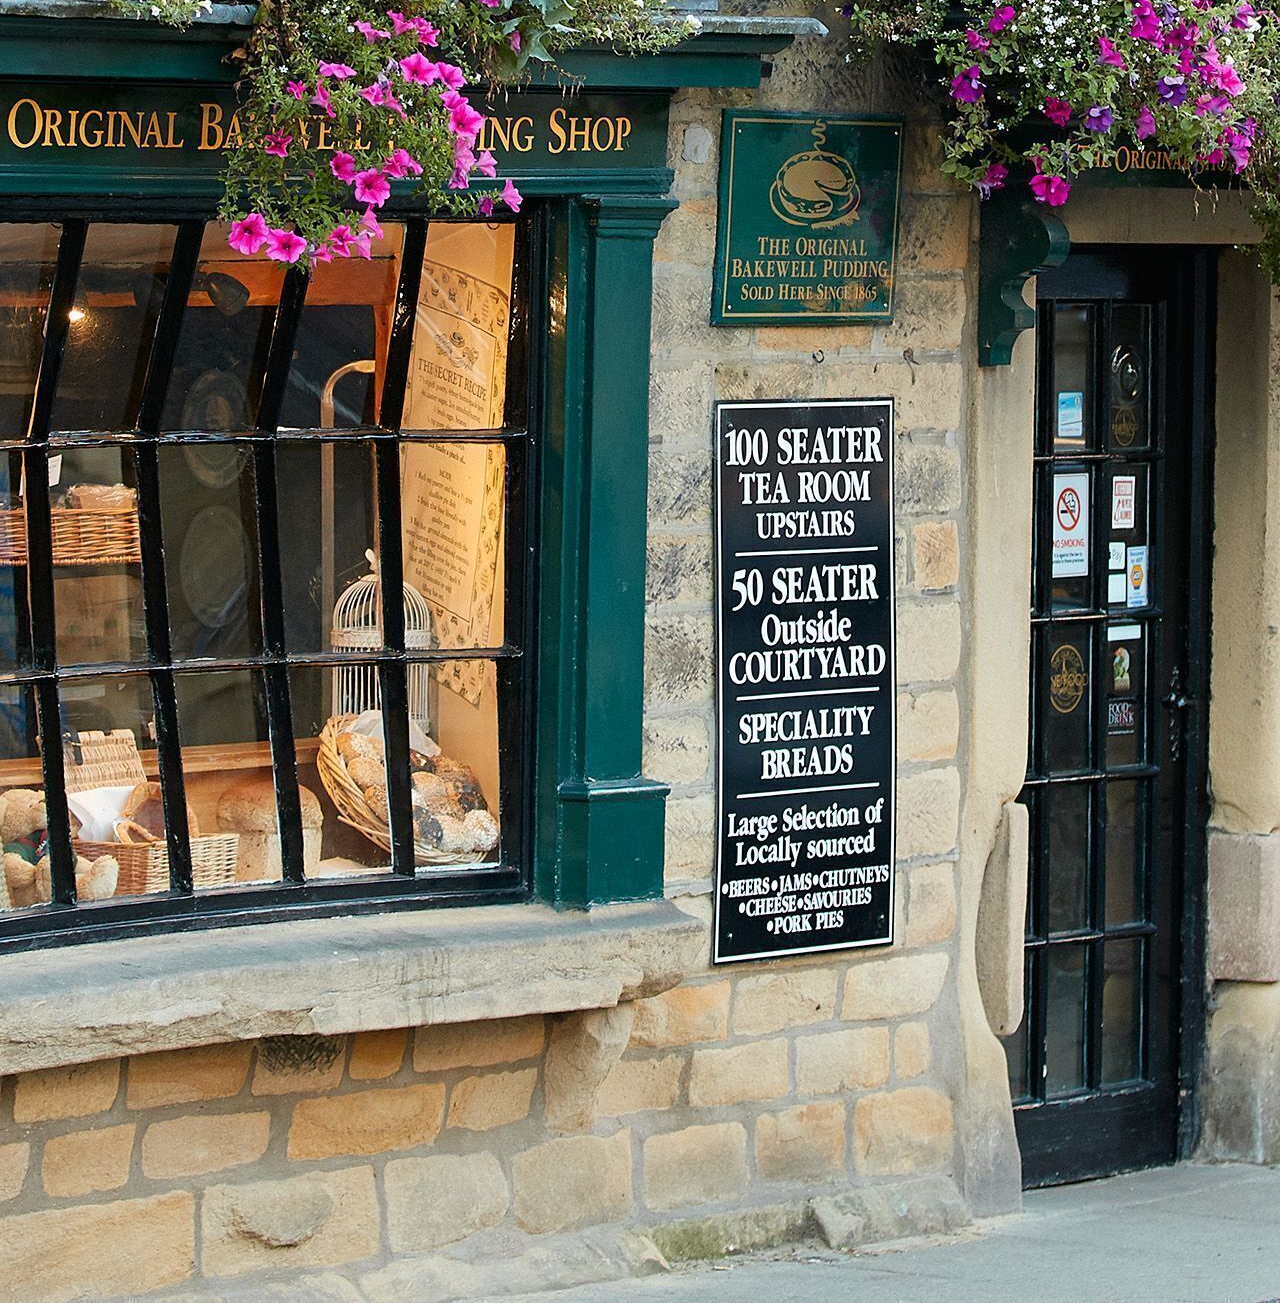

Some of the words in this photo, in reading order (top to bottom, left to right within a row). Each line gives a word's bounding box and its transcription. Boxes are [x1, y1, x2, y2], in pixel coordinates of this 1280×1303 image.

[7, 98, 184, 150] ORIGINAL
[548, 108, 632, 154] SHOP
[758, 236, 790, 256] THE
[795, 236, 868, 256] ORIGINAL
[731, 258, 817, 278] BAKEWELL
[822, 259, 888, 278] PUDDING
[740, 283, 774, 300] SOLD
[778, 284, 814, 300] HERE
[817, 283, 849, 300] SINCE
[854, 285, 877, 302] 1865
[418, 358, 434, 375] THE
[434, 365, 464, 388] SECRET
[464, 378, 488, 401] RECIPE
[724, 428, 769, 466] 100
[777, 426, 884, 465] SEATER
[738, 471, 791, 505] TEA
[797, 470, 871, 504] ROOM
[755, 509, 856, 539] UPSTAIRS
[1061, 538, 1085, 548] SMOKING
[731, 568, 764, 612] 50
[771, 563, 880, 605] SEATER
[761, 607, 853, 647] Outside
[728, 643, 887, 685] COURTYARD
[738, 705, 875, 745] SPECIALITY
[761, 743, 854, 780] BREADS
[727, 813, 778, 841] Large
[782, 802, 860, 833] Selection
[864, 797, 885, 824] of
[735, 835, 802, 868] Locally
[807, 828, 876, 860] sourced
[816, 910, 844, 930] PIES
